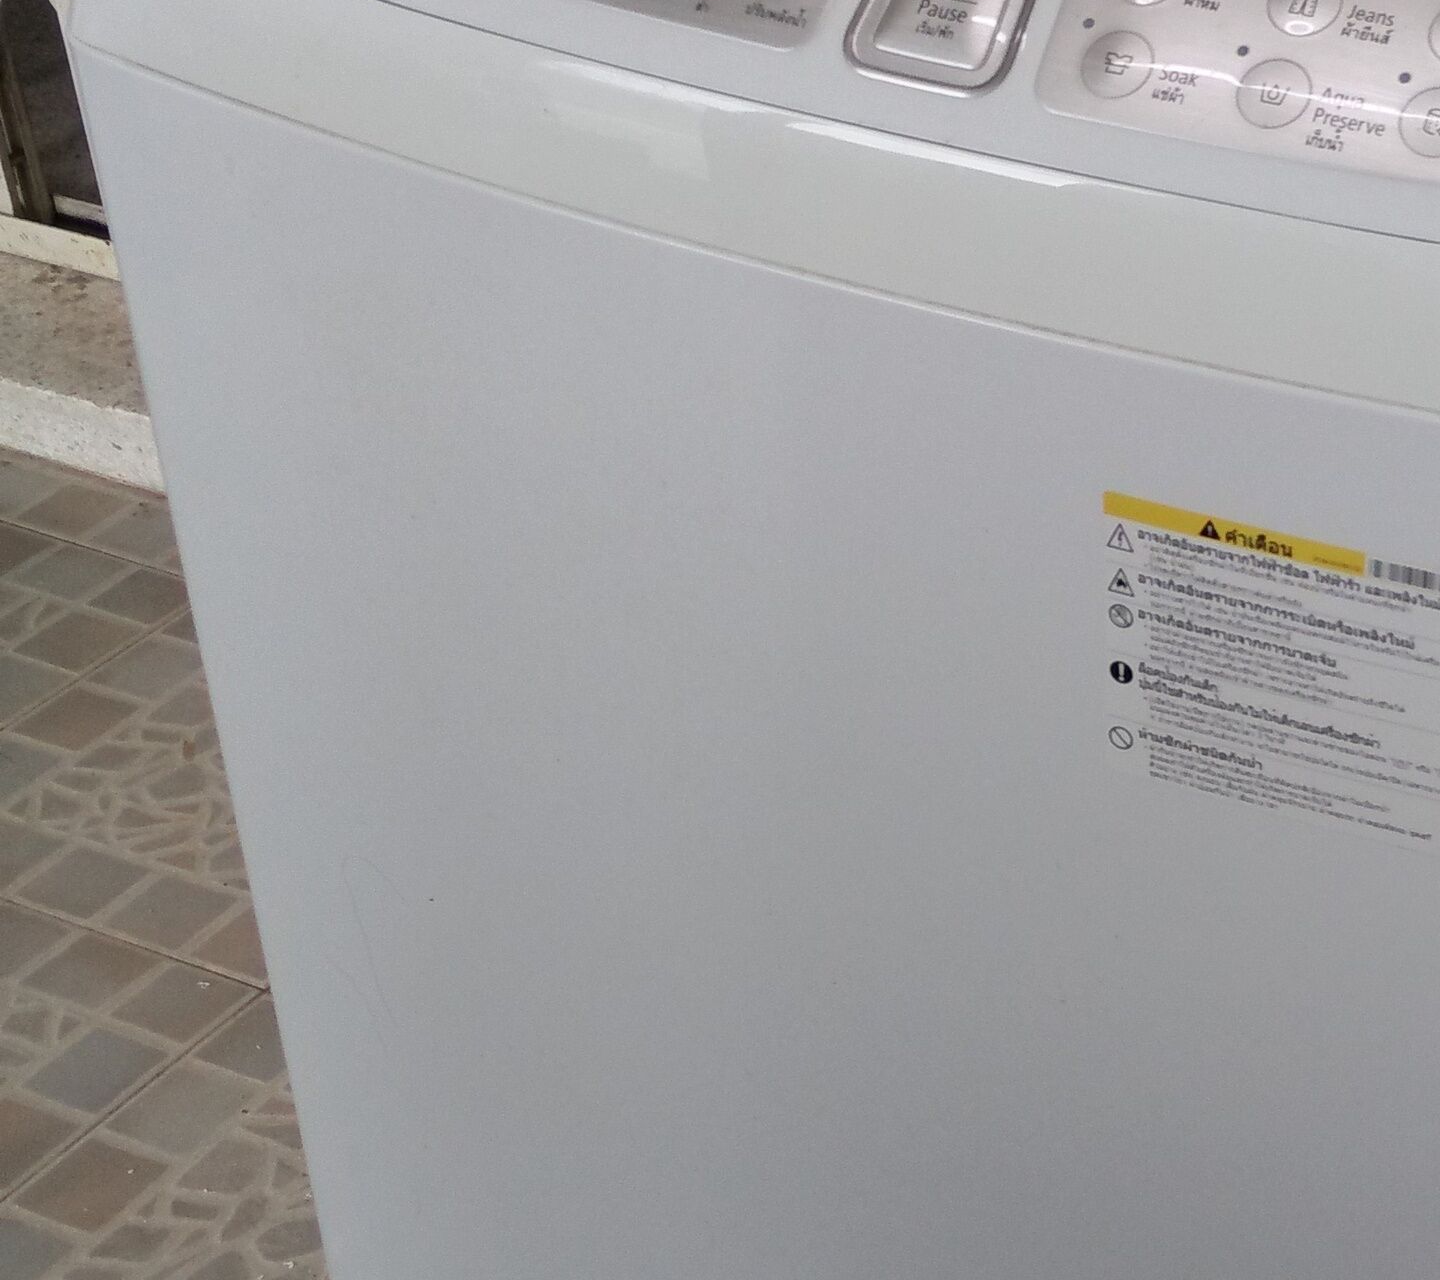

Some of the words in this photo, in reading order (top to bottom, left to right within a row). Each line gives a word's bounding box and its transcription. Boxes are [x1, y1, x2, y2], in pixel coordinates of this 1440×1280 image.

[1347, 4, 1395, 28] Jeans
[1312, 107, 1386, 138] Preserve
[1225, 528, 1294, 558] คำเตือน
